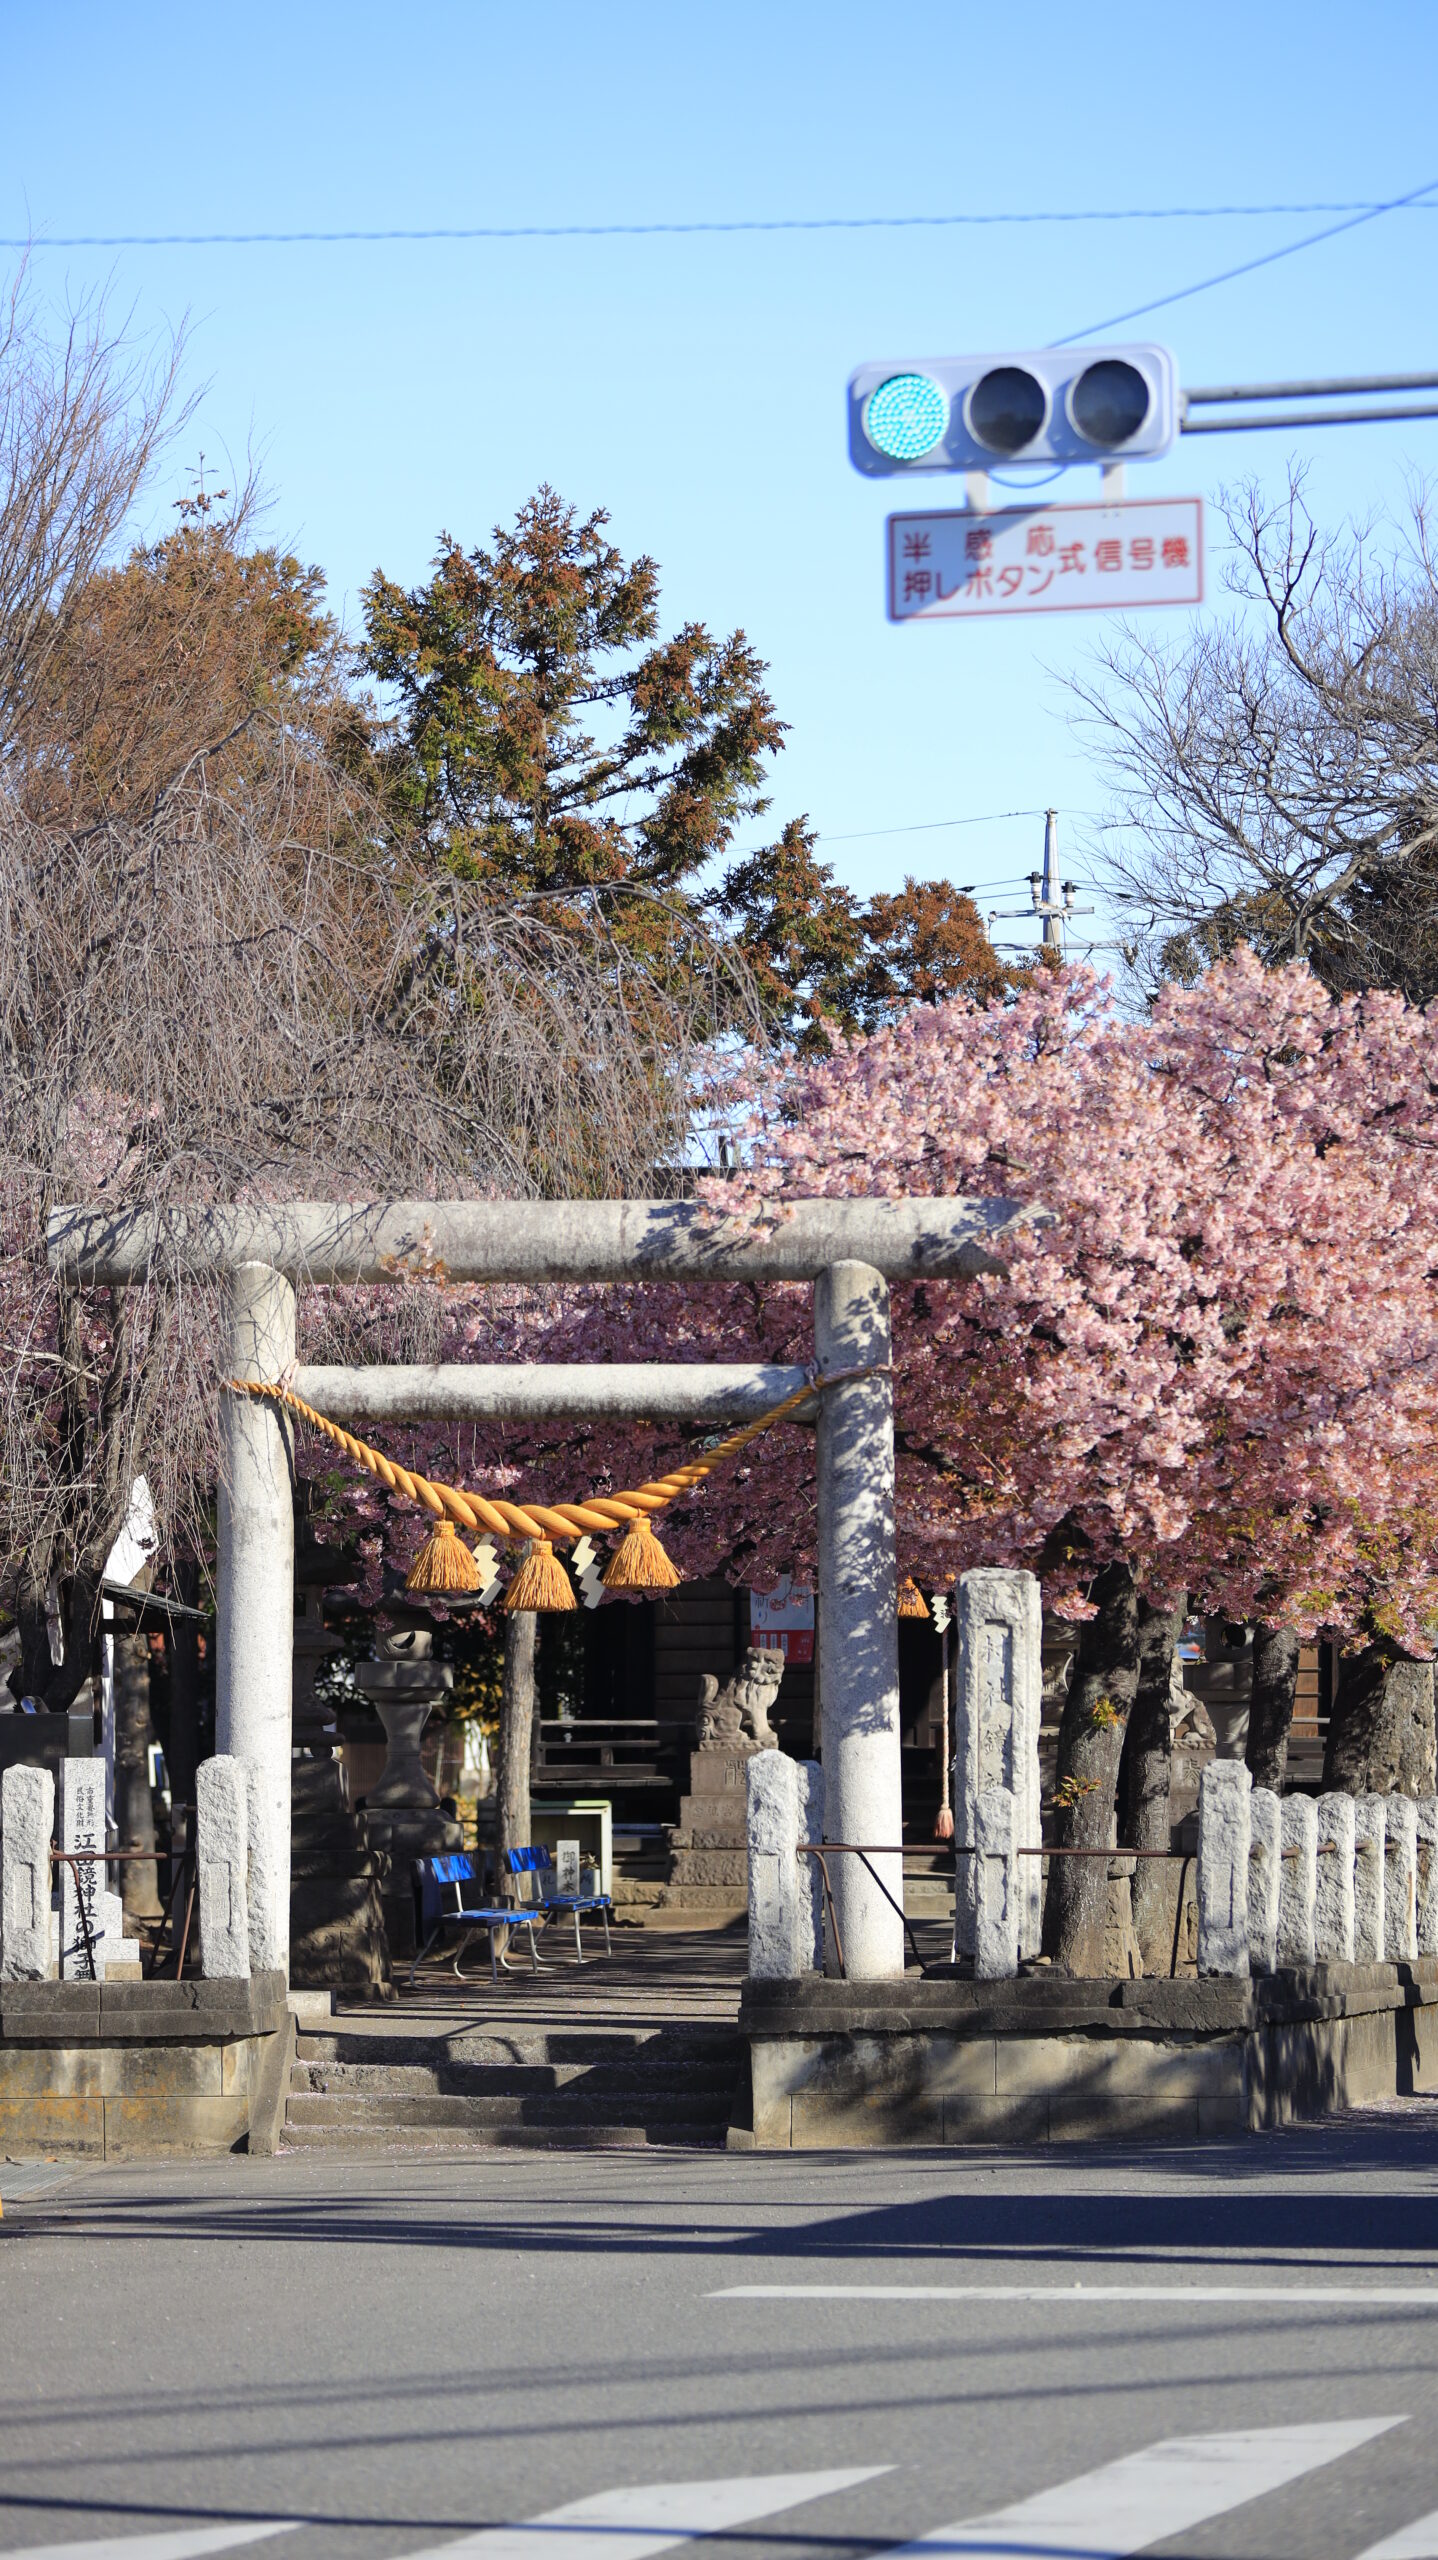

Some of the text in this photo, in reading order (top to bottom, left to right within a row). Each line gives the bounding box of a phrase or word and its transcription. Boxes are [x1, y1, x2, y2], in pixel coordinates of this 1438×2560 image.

[903, 525, 1055, 564] 半感応
[1058, 536, 1190, 575] 式信号機
[903, 566, 1055, 602] 押しボタン
